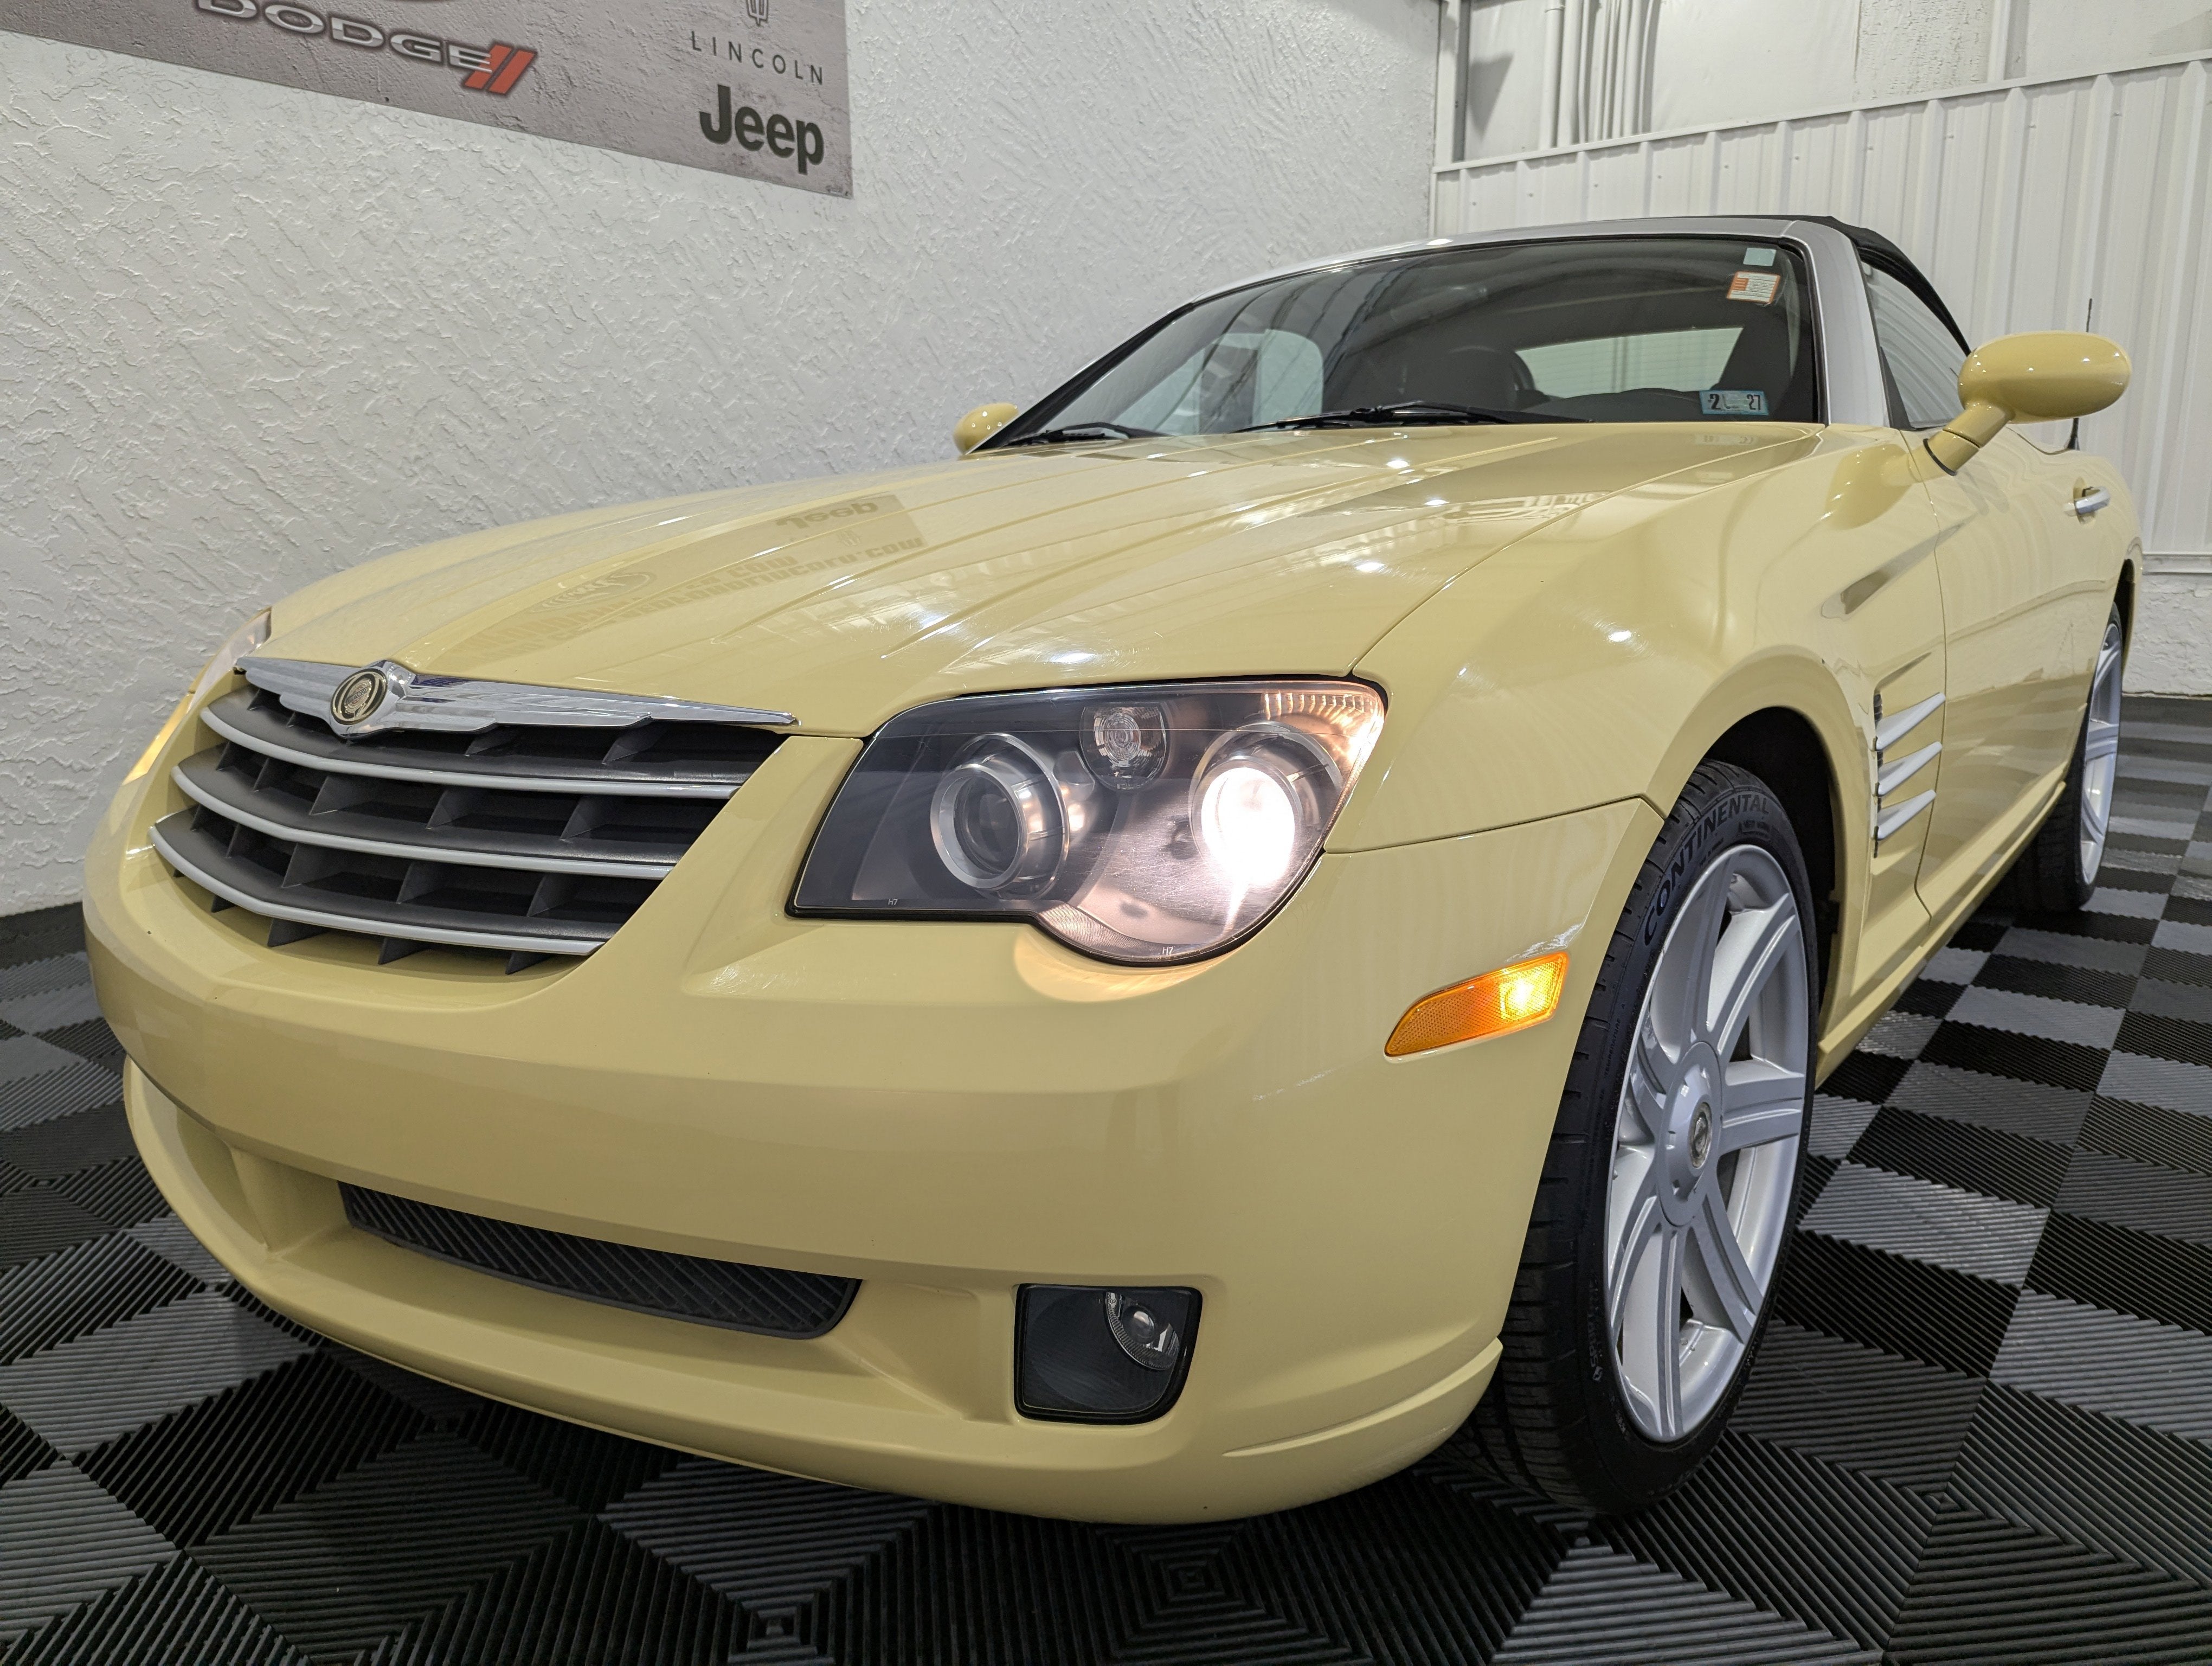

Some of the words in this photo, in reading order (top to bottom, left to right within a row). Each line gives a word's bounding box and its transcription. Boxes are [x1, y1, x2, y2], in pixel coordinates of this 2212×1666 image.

[198, 0, 493, 73] DODGE
[691, 30, 823, 86] LINCOLN
[699, 84, 825, 176] Jeep
[1746, 394, 1761, 411] 27
[1643, 793, 1770, 946] CONTINENTAL
[1162, 946, 1174, 956] H7
